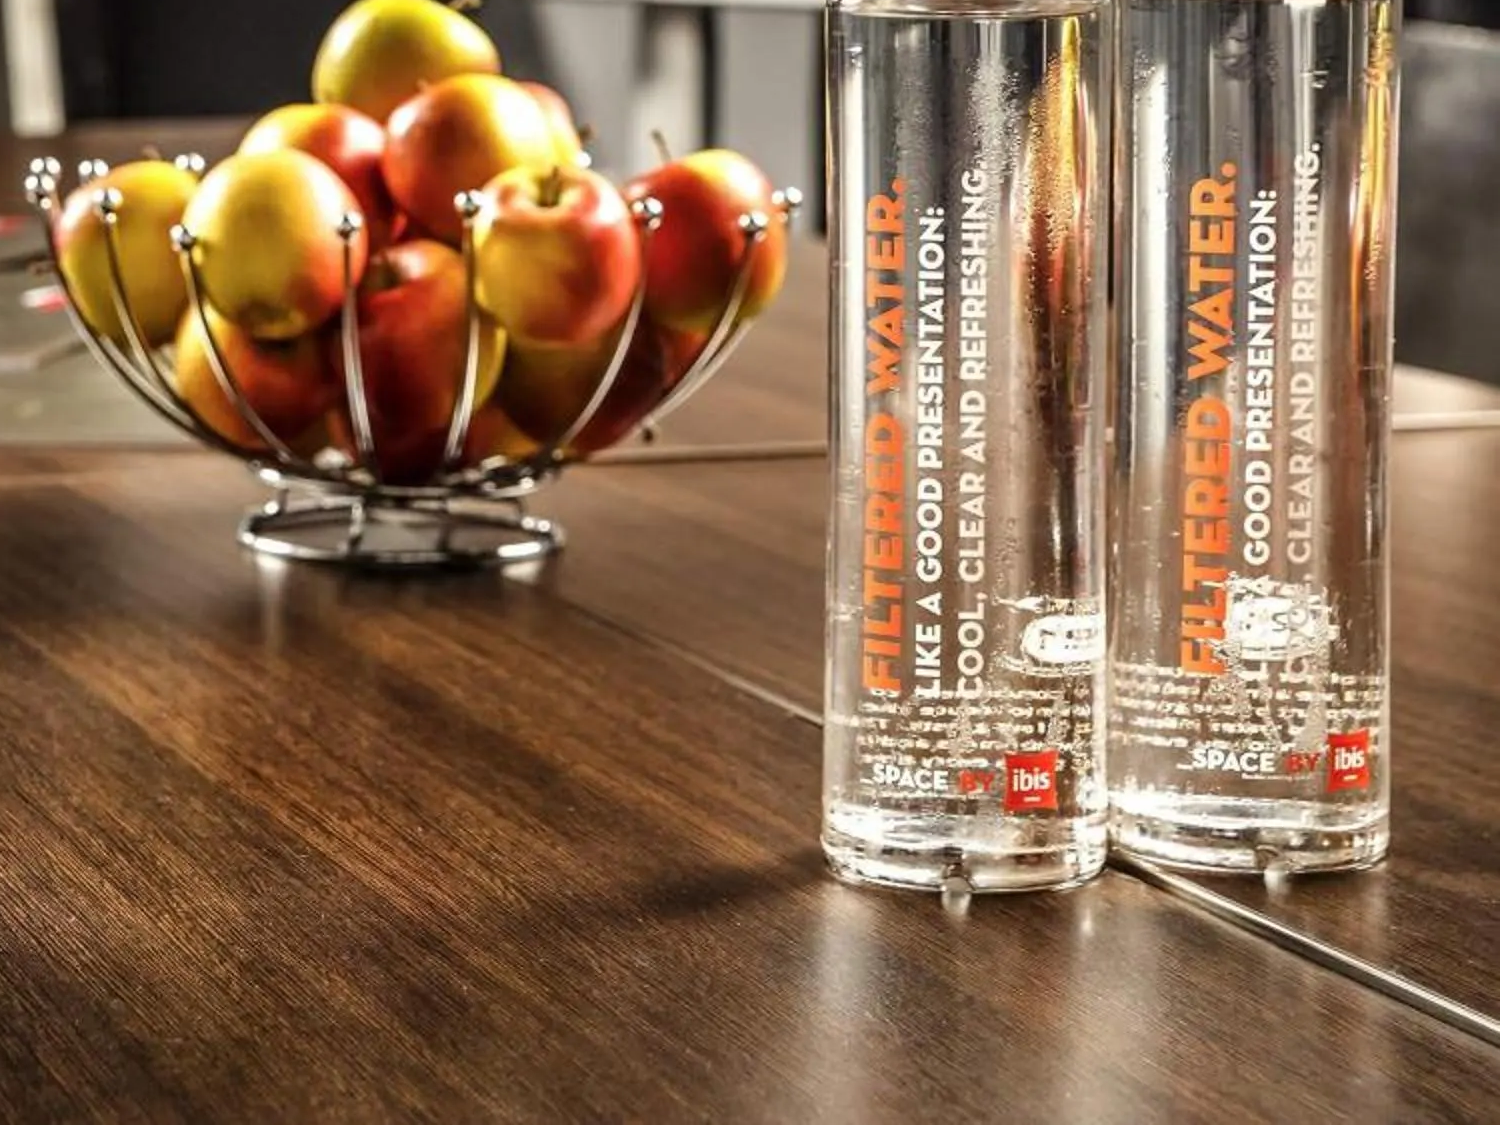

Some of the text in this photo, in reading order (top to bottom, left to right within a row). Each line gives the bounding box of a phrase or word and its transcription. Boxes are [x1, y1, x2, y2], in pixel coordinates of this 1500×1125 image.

[1245, 189, 1277, 451] PRESENTATION:
[1290, 142, 1321, 363] REFRESHING.
[863, 177, 907, 691] FILTERED WATER.
[914, 206, 946, 700] LIKE A GOOD PRESENTATION:
[956, 160, 990, 701] COOL, CLEAR AND REFRESHING.
[1180, 161, 1237, 675] FILTERED WATER.
[1243, 459, 1272, 566] GOOD
[1286, 450, 1313, 564] CLEAR
[1289, 371, 1315, 445] AND
[957, 770, 996, 794] BY
[1012, 768, 1050, 793] ibis
[1285, 751, 1322, 772] BY
[1334, 746, 1366, 771] ibis
